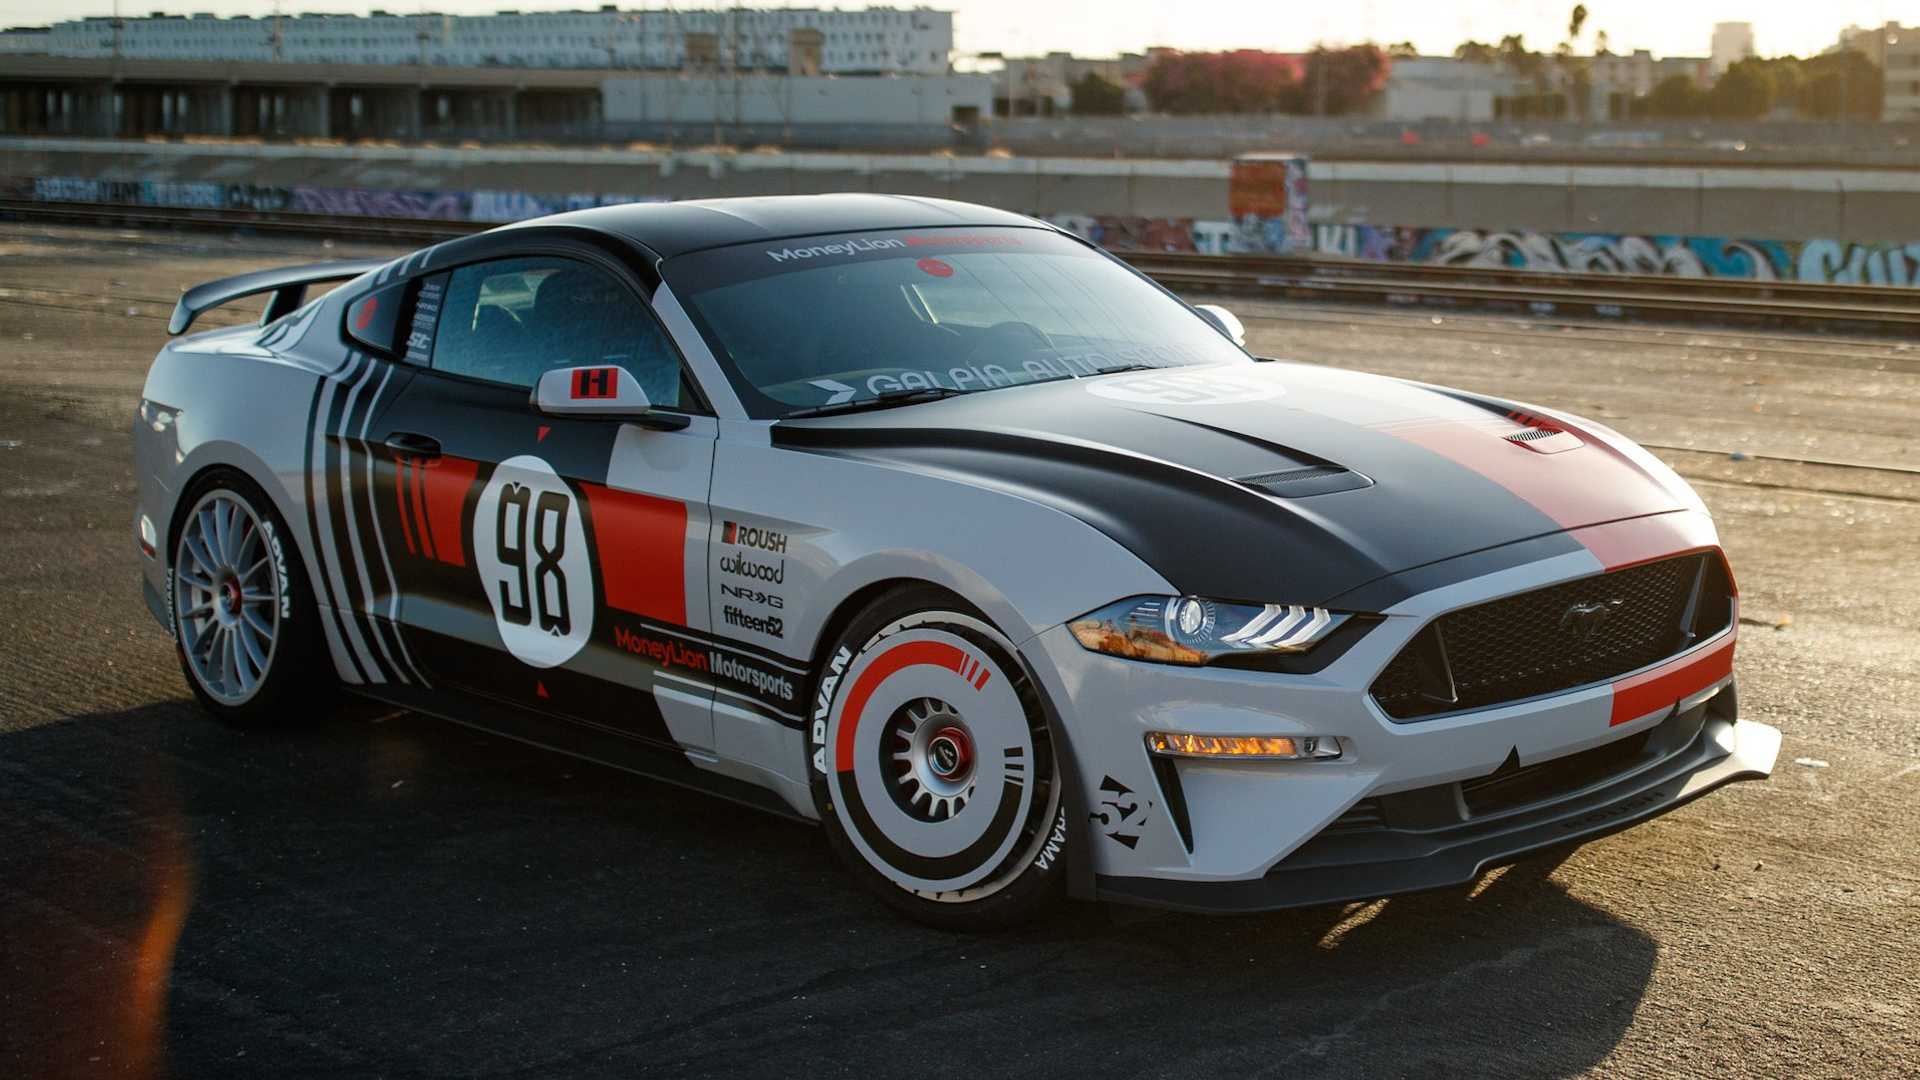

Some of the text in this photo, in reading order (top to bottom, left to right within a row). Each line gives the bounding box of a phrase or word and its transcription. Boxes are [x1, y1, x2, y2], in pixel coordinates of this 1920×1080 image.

[767, 238, 905, 262] MoneyLion
[1021, 352, 1114, 378] AUTO
[738, 526, 787, 553] ROUSH
[262, 520, 290, 619] ADVAN
[497, 482, 570, 636] 98
[720, 552, 784, 584] wilwood
[724, 605, 783, 639] fifteen52
[614, 626, 793, 700] MoneyLion Motorsports
[812, 646, 852, 775] ADVAN
